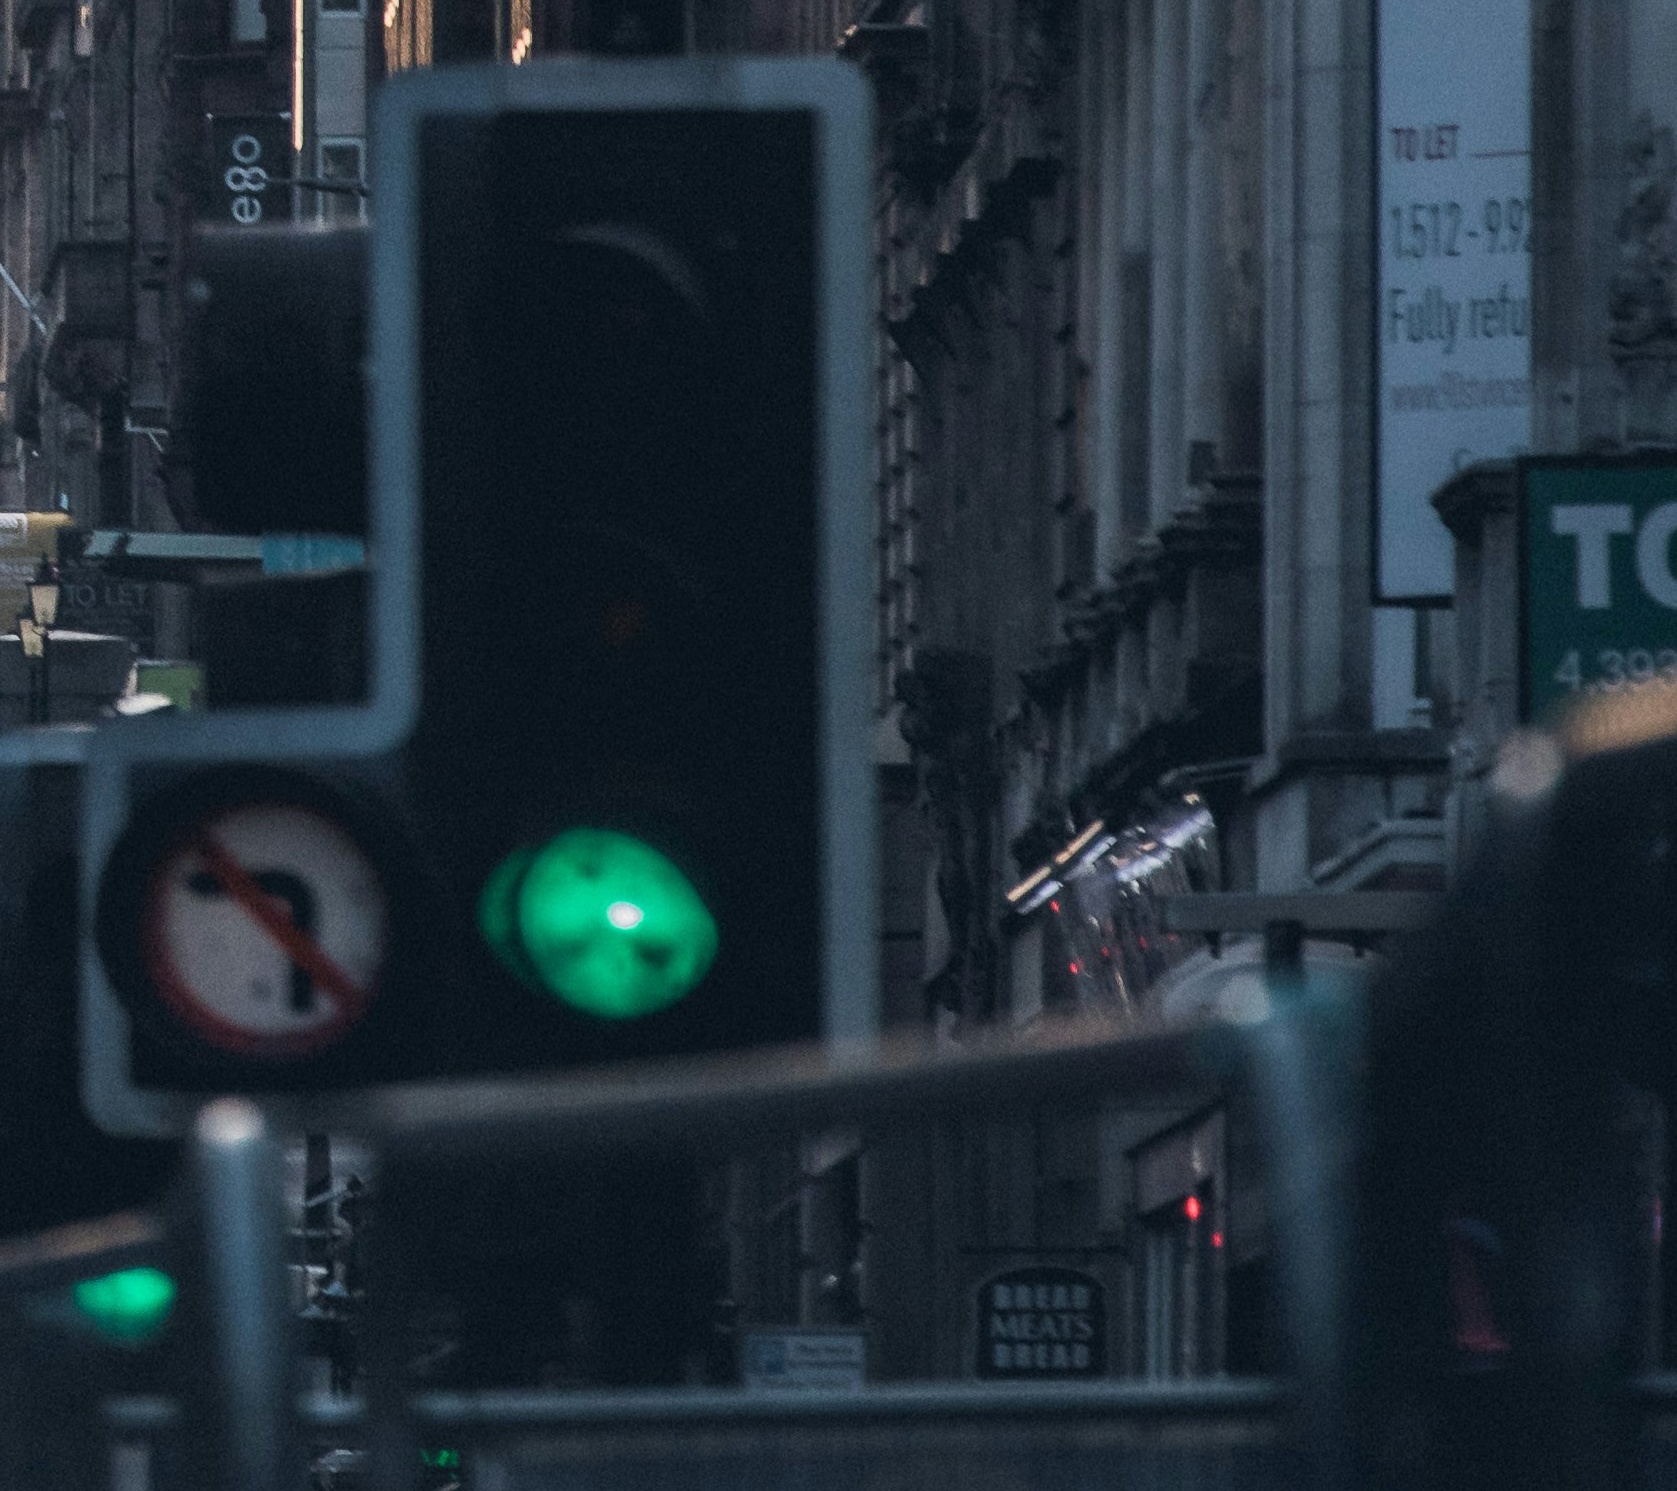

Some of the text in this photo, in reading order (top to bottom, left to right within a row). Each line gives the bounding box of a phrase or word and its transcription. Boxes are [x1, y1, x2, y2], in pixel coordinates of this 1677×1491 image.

[1389, 123, 1461, 161] TO LET
[1389, 285, 1461, 356] Fully
[989, 1314, 1094, 1340] MEATS
